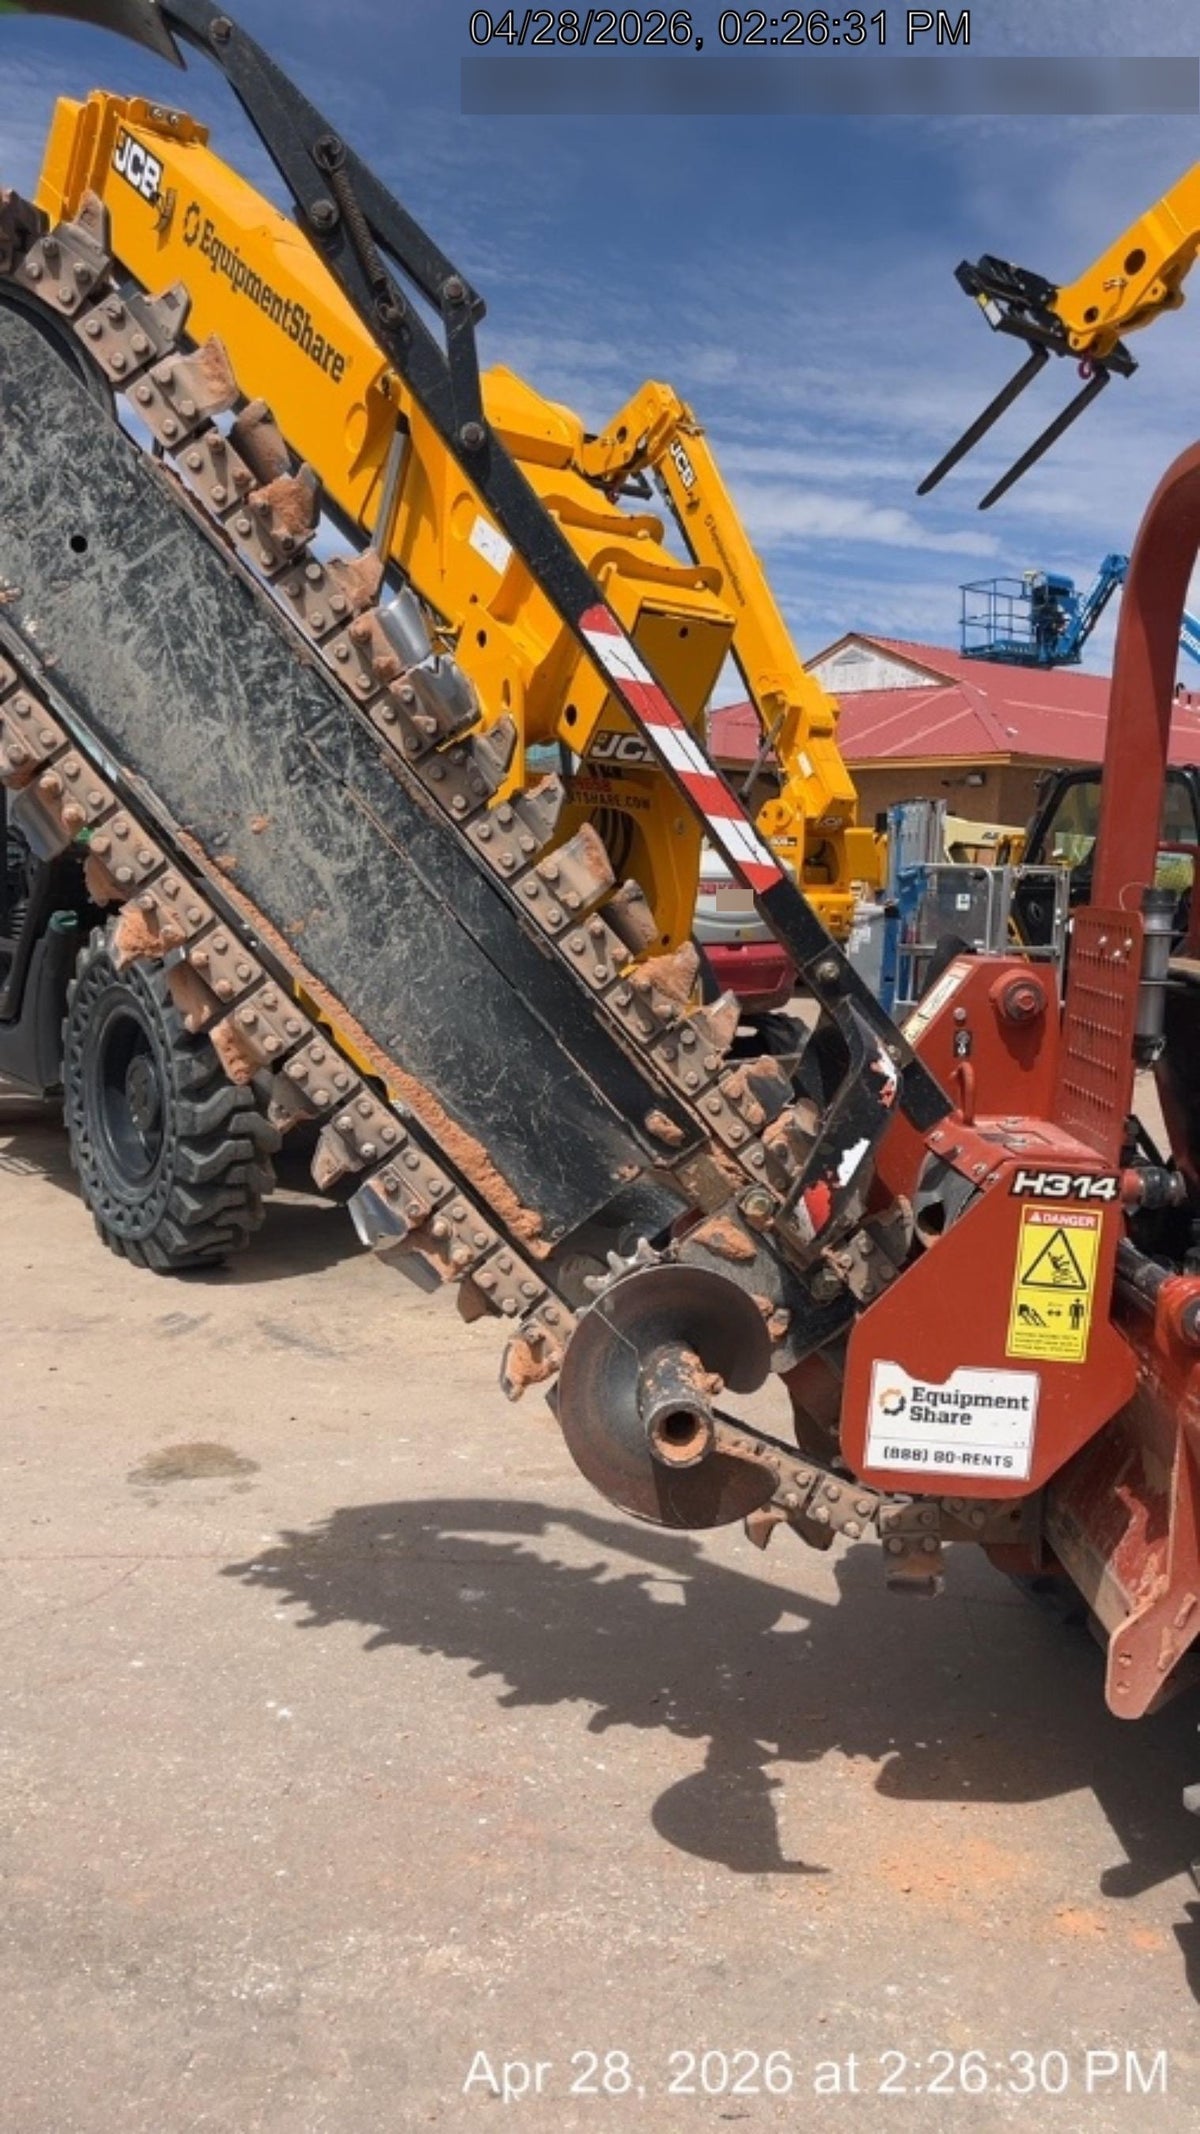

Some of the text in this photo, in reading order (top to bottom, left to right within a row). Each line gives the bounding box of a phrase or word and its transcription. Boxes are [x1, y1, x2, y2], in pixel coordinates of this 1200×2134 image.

[113, 133, 162, 198] JCB
[199, 218, 347, 383] EquipmentShare
[670, 441, 695, 488] JCB
[591, 733, 657, 763] JC
[1010, 1170, 1118, 1201] H314
[1042, 1214, 1096, 1227] DANGER
[911, 1386, 1030, 1411] Equipment
[909, 1405, 973, 1426] Share
[883, 1446, 1014, 1469] (888) 80-RENTS
